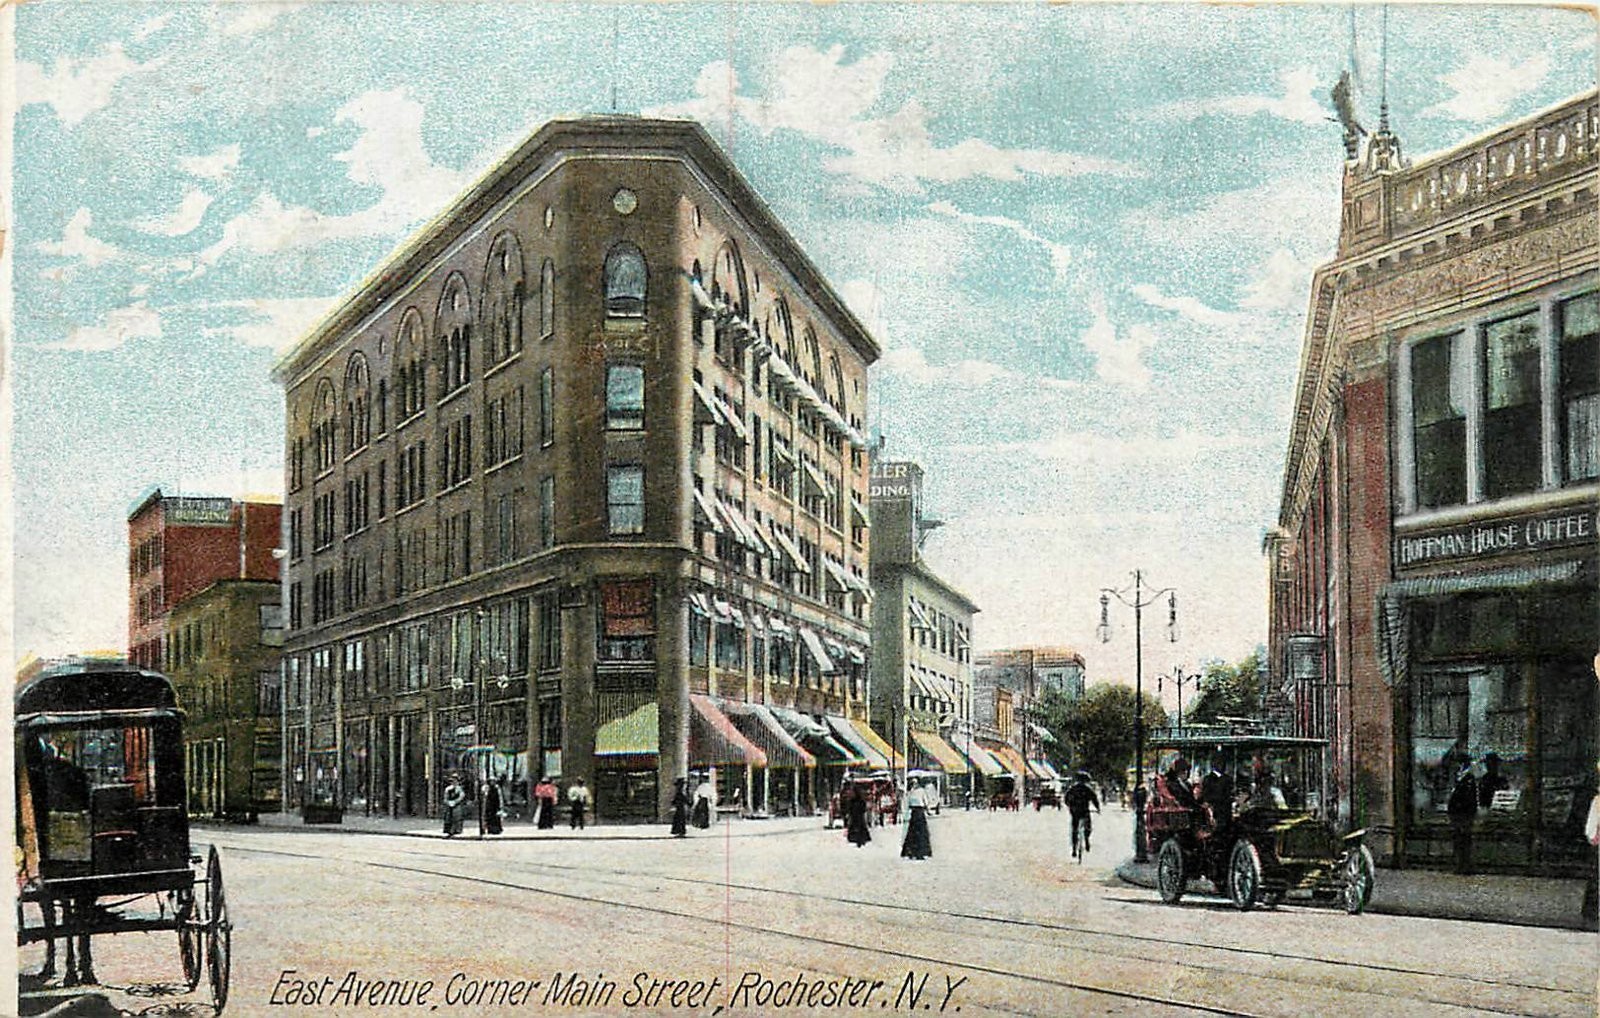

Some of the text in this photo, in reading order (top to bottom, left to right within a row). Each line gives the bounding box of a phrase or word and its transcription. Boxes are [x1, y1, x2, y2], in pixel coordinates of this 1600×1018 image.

[1401, 513, 1589, 563] HOFFMAN HOUSE COFFEE
